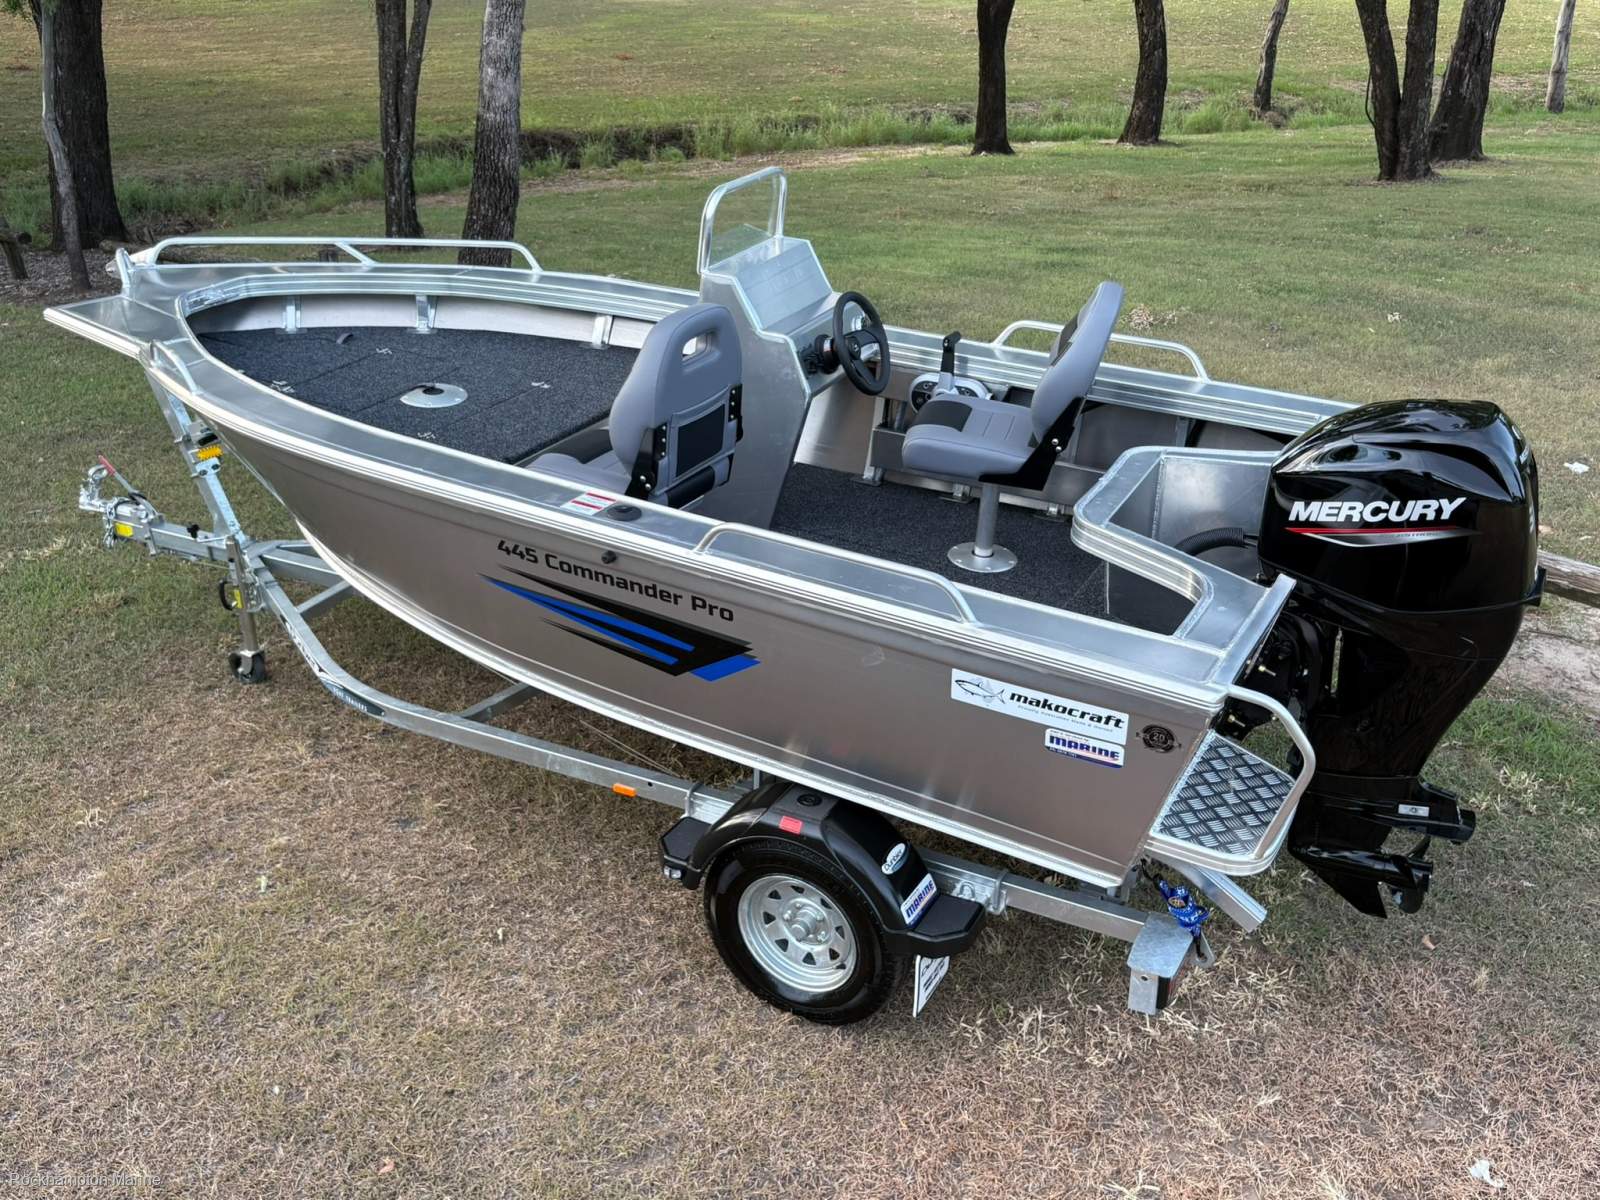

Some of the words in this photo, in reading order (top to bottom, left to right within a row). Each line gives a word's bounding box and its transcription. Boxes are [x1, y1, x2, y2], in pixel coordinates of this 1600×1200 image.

[1288, 497, 1467, 522] MERCURY
[497, 540, 539, 564] 445
[545, 553, 683, 605] Commander
[692, 595, 734, 622] Pro
[1009, 691, 1125, 728] makocraft
[1049, 735, 1120, 760] MARINE
[906, 881, 935, 918] MARINE
